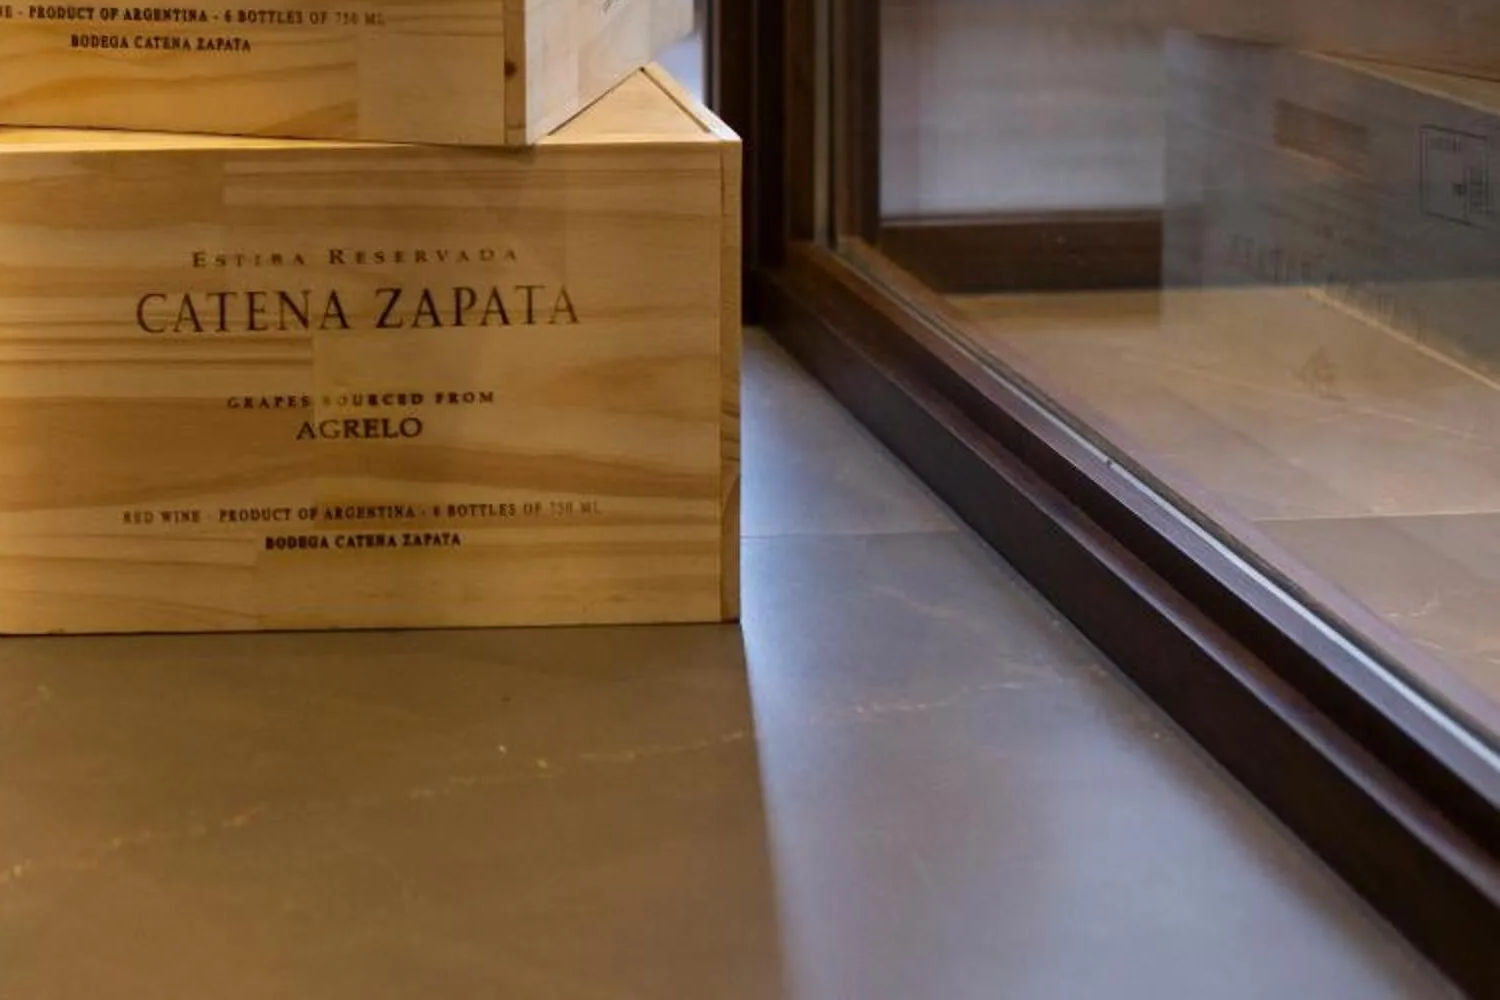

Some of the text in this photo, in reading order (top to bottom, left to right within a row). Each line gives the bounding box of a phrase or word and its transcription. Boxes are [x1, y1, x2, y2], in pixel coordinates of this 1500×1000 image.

[28, 6, 95, 20] PRODUCT
[100, 7, 119, 21] OF
[123, 7, 208, 22] ARGENTINA
[224, 9, 232, 23] 6
[237, 9, 303, 24] BOTTLES
[309, 11, 328, 25] OF
[364, 11, 386, 26] ML
[70, 34, 251, 52] BODEGA CATENA ZAPATA
[328, 248, 518, 265] RESERVADA
[135, 285, 582, 334] CATENA ZAPATA
[227, 391, 494, 409] GRAPES SOURCED FROM
[296, 416, 423, 441] AGRELO
[123, 510, 154, 525] RED
[160, 509, 200, 524] WINE
[218, 507, 292, 523] PRODUCT
[298, 507, 317, 521] OF
[324, 504, 416, 521] ARGENTINA
[446, 503, 517, 518] BOTTLES
[523, 503, 542, 517] OF
[581, 501, 603, 515] ML
[265, 532, 461, 550] BODEGA CATENA ZAPATA
